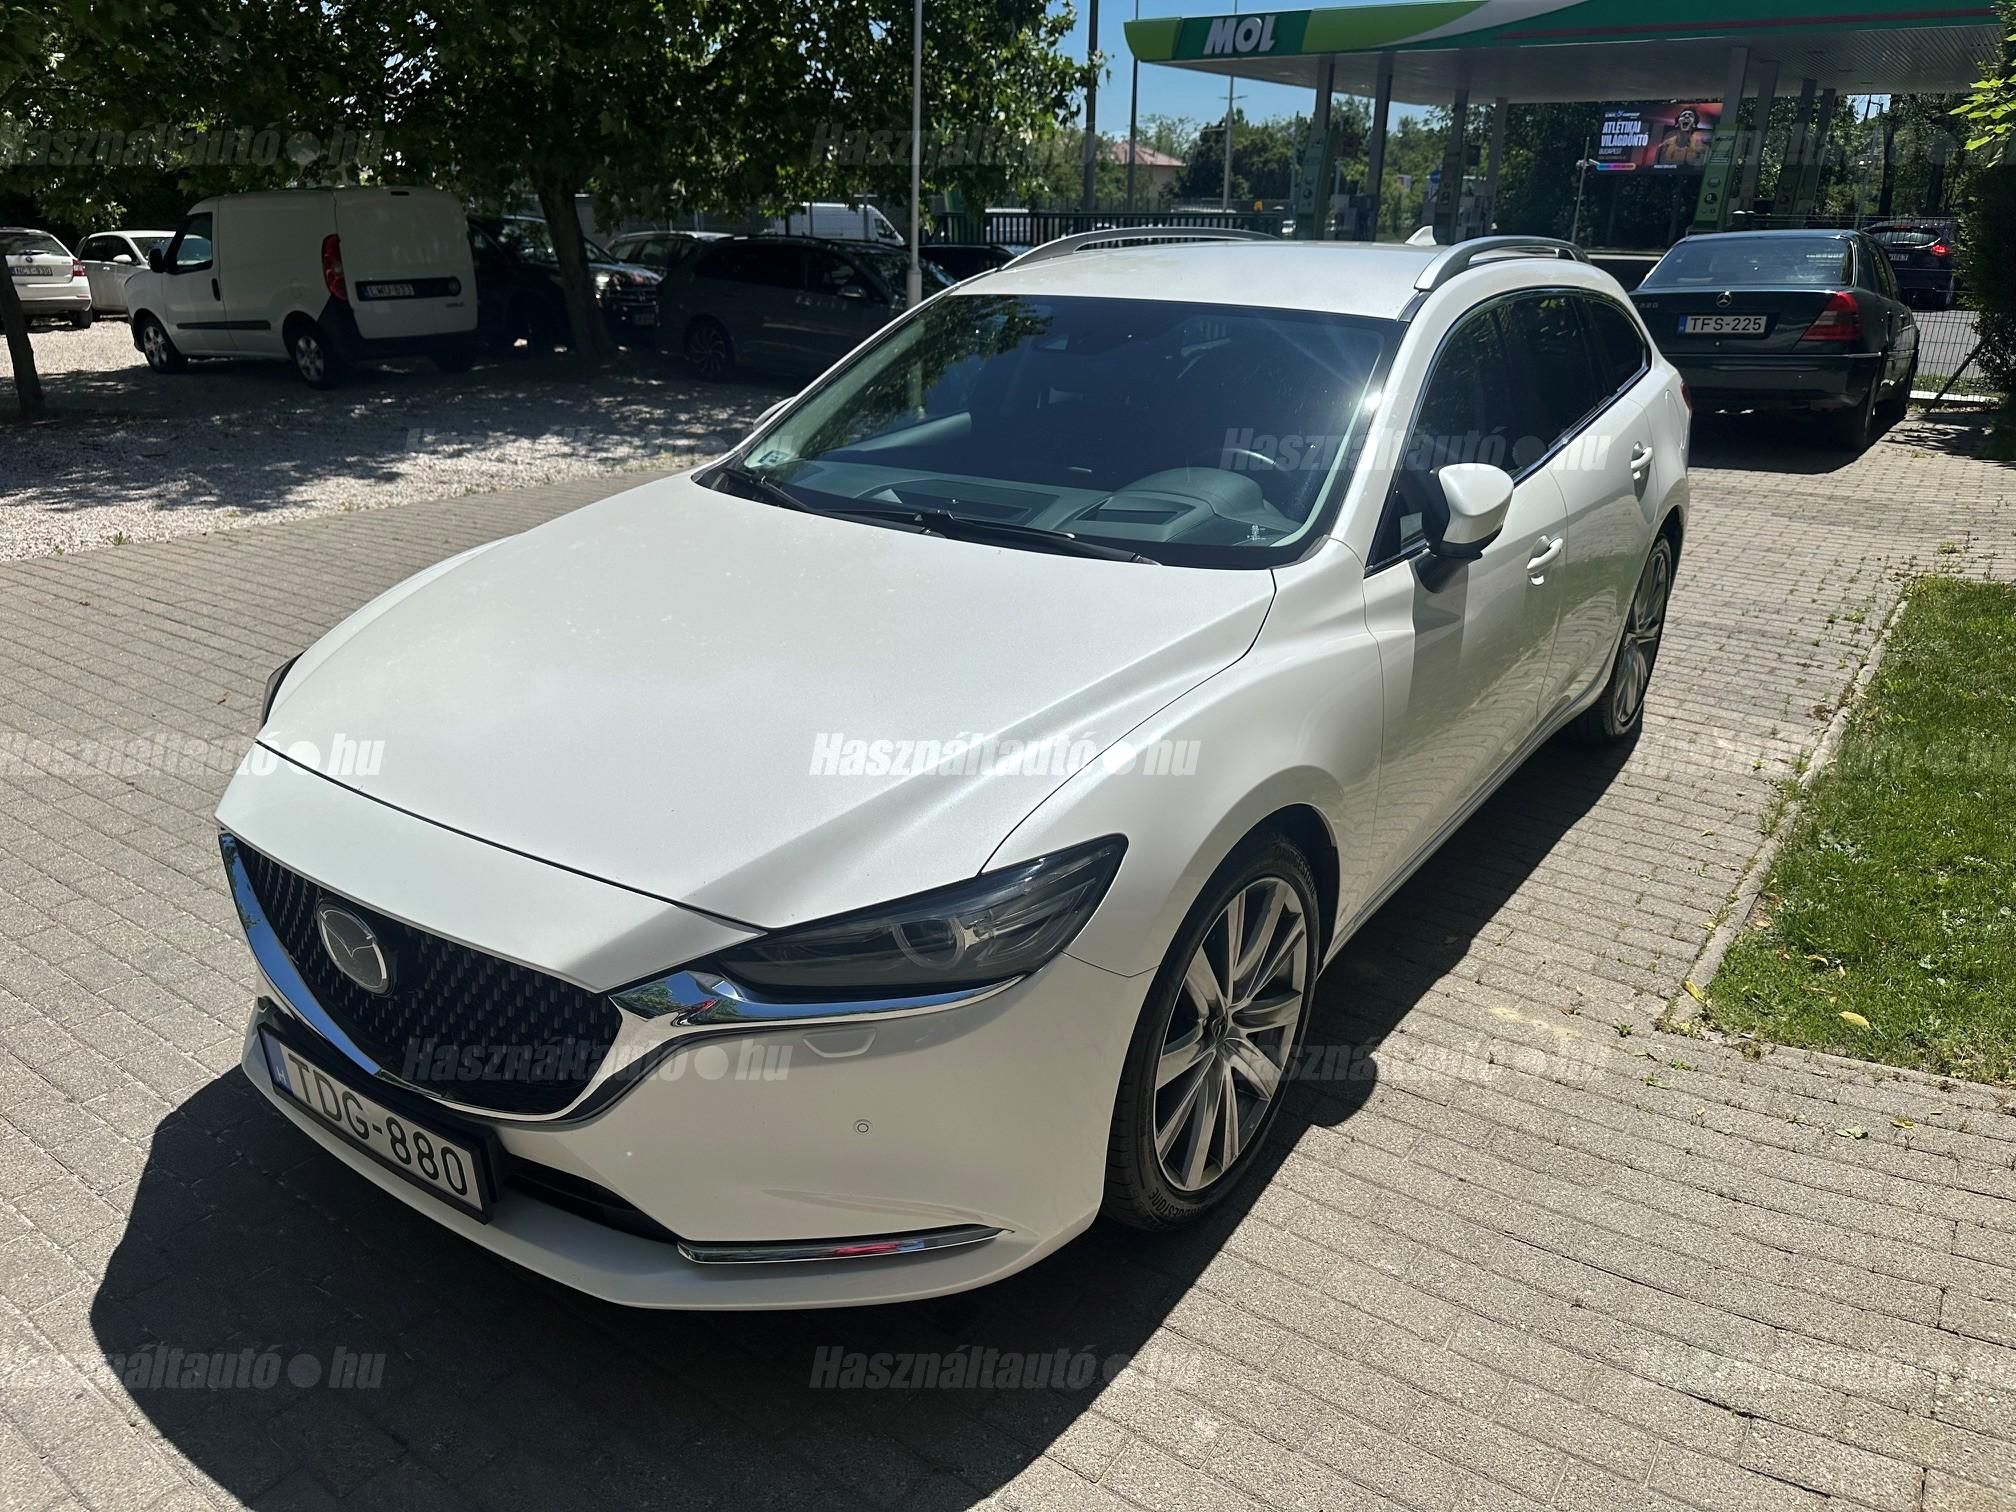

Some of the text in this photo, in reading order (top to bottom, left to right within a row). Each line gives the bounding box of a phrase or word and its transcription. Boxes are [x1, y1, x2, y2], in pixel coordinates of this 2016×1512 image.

[1203, 15, 1276, 55] MOL
[1691, 318, 1762, 331] TFS-225
[288, 1053, 468, 1197] TDG-880
